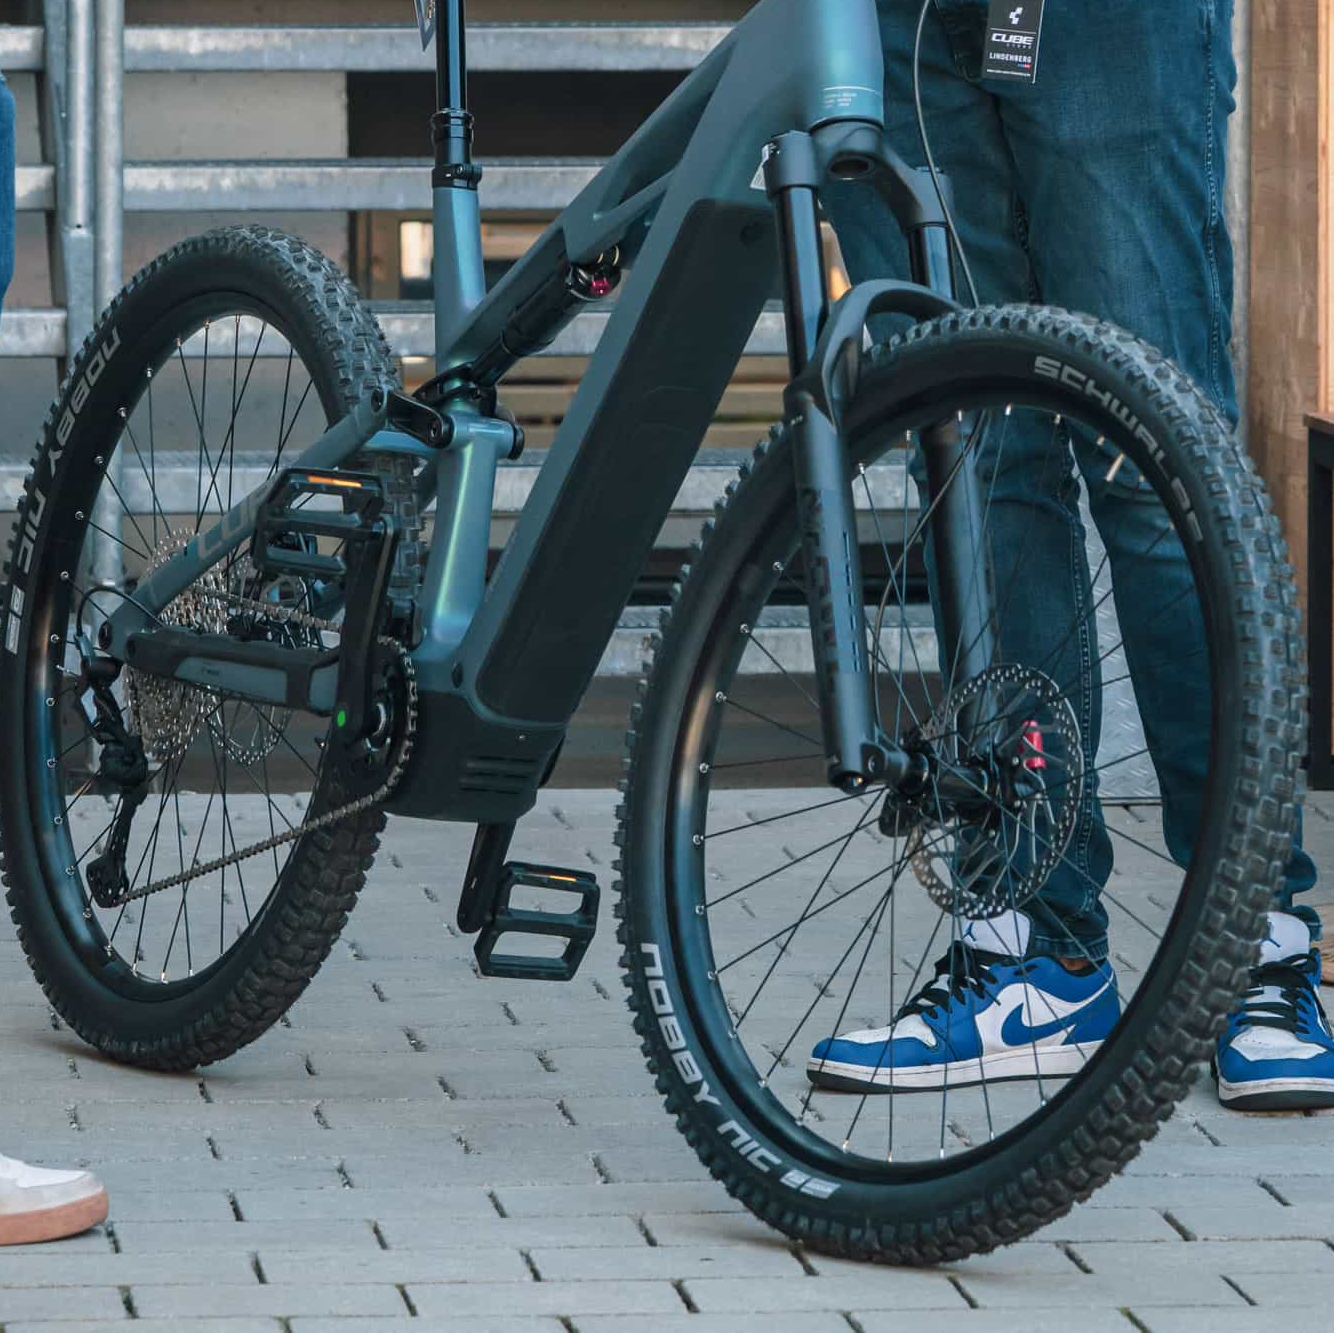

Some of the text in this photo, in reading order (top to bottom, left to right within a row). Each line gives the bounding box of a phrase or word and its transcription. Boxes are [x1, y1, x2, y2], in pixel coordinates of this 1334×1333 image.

[991, 32, 1036, 46] CUBE
[1034, 355, 1204, 542] SCHWALBE
[17, 491, 47, 575] NIC
[641, 942, 783, 1173] NOBBY NIC
